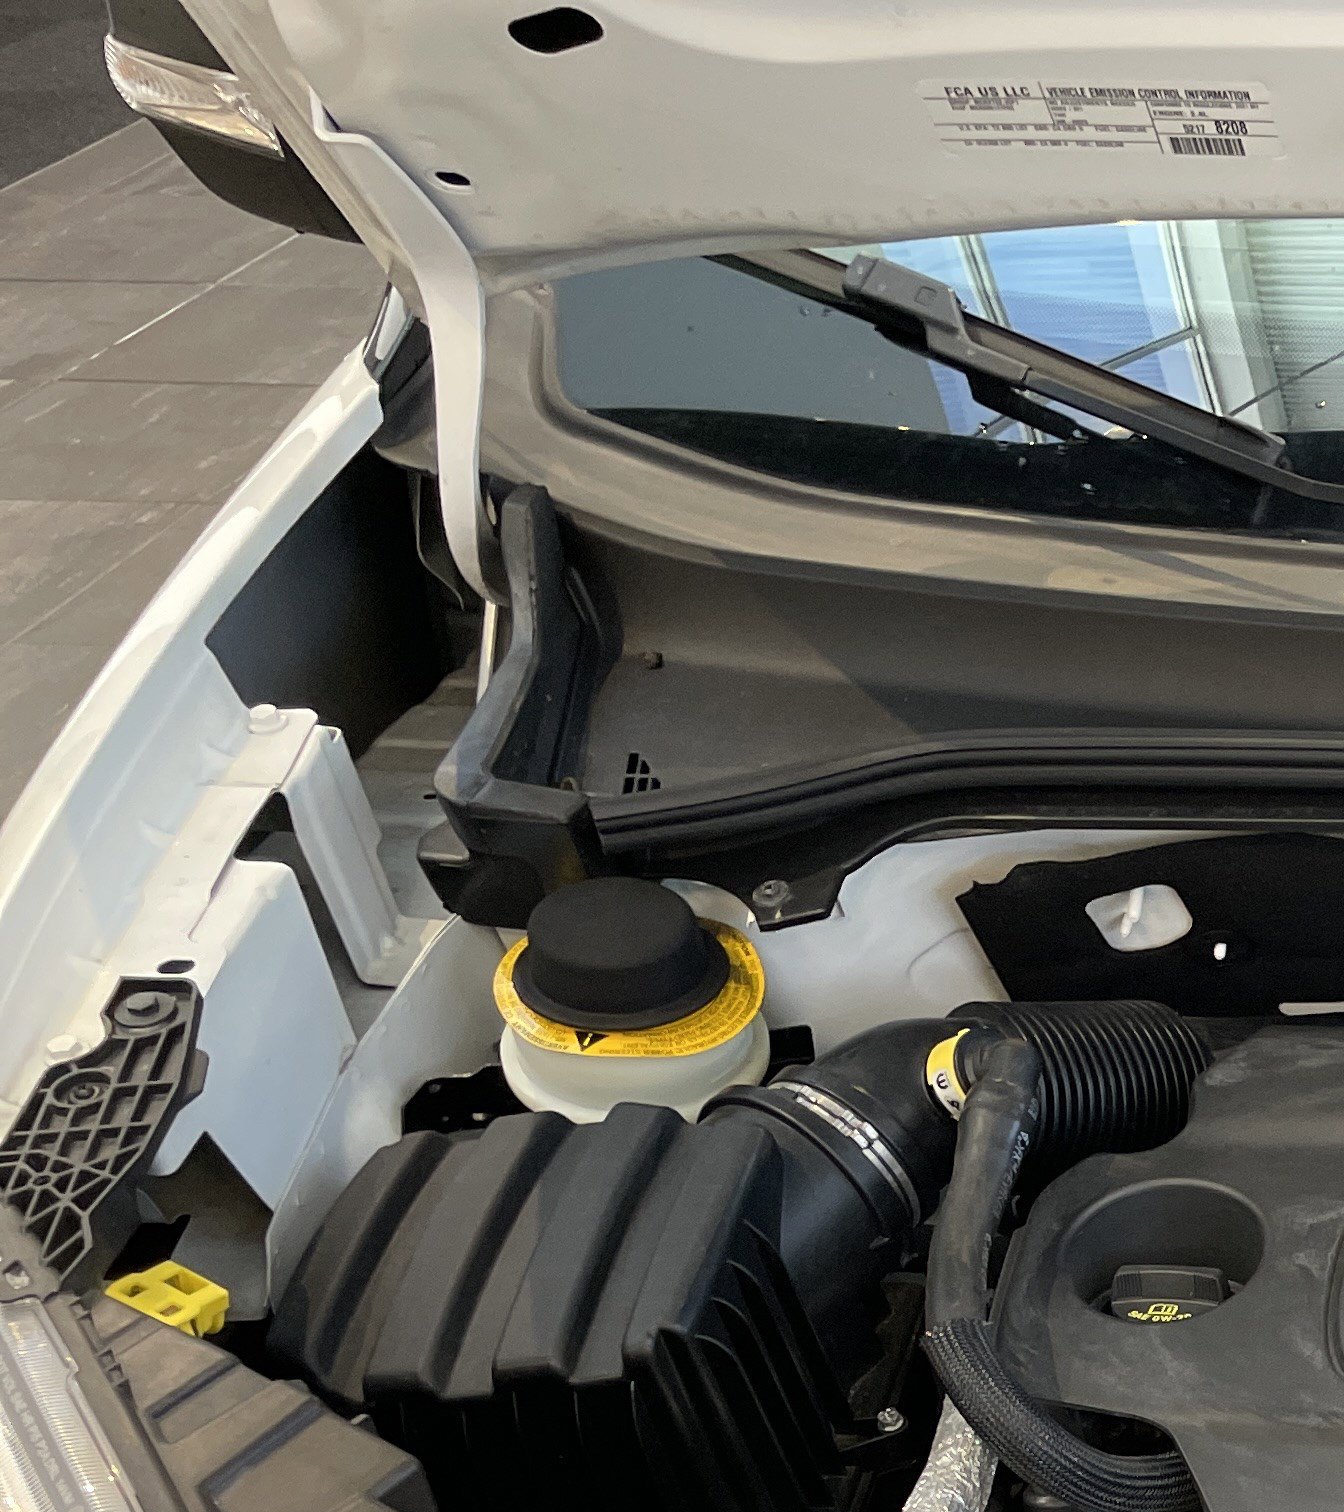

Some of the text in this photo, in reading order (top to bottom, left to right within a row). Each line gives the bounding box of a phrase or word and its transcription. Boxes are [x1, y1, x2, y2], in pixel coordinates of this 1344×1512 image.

[944, 86, 1030, 97] FCA US LLC
[1046, 87, 1251, 100] VEHICLE EMISSION CONTROL INFORMATION
[1215, 120, 1248, 135] 8208
[1128, 1310, 1150, 1320] SAE
